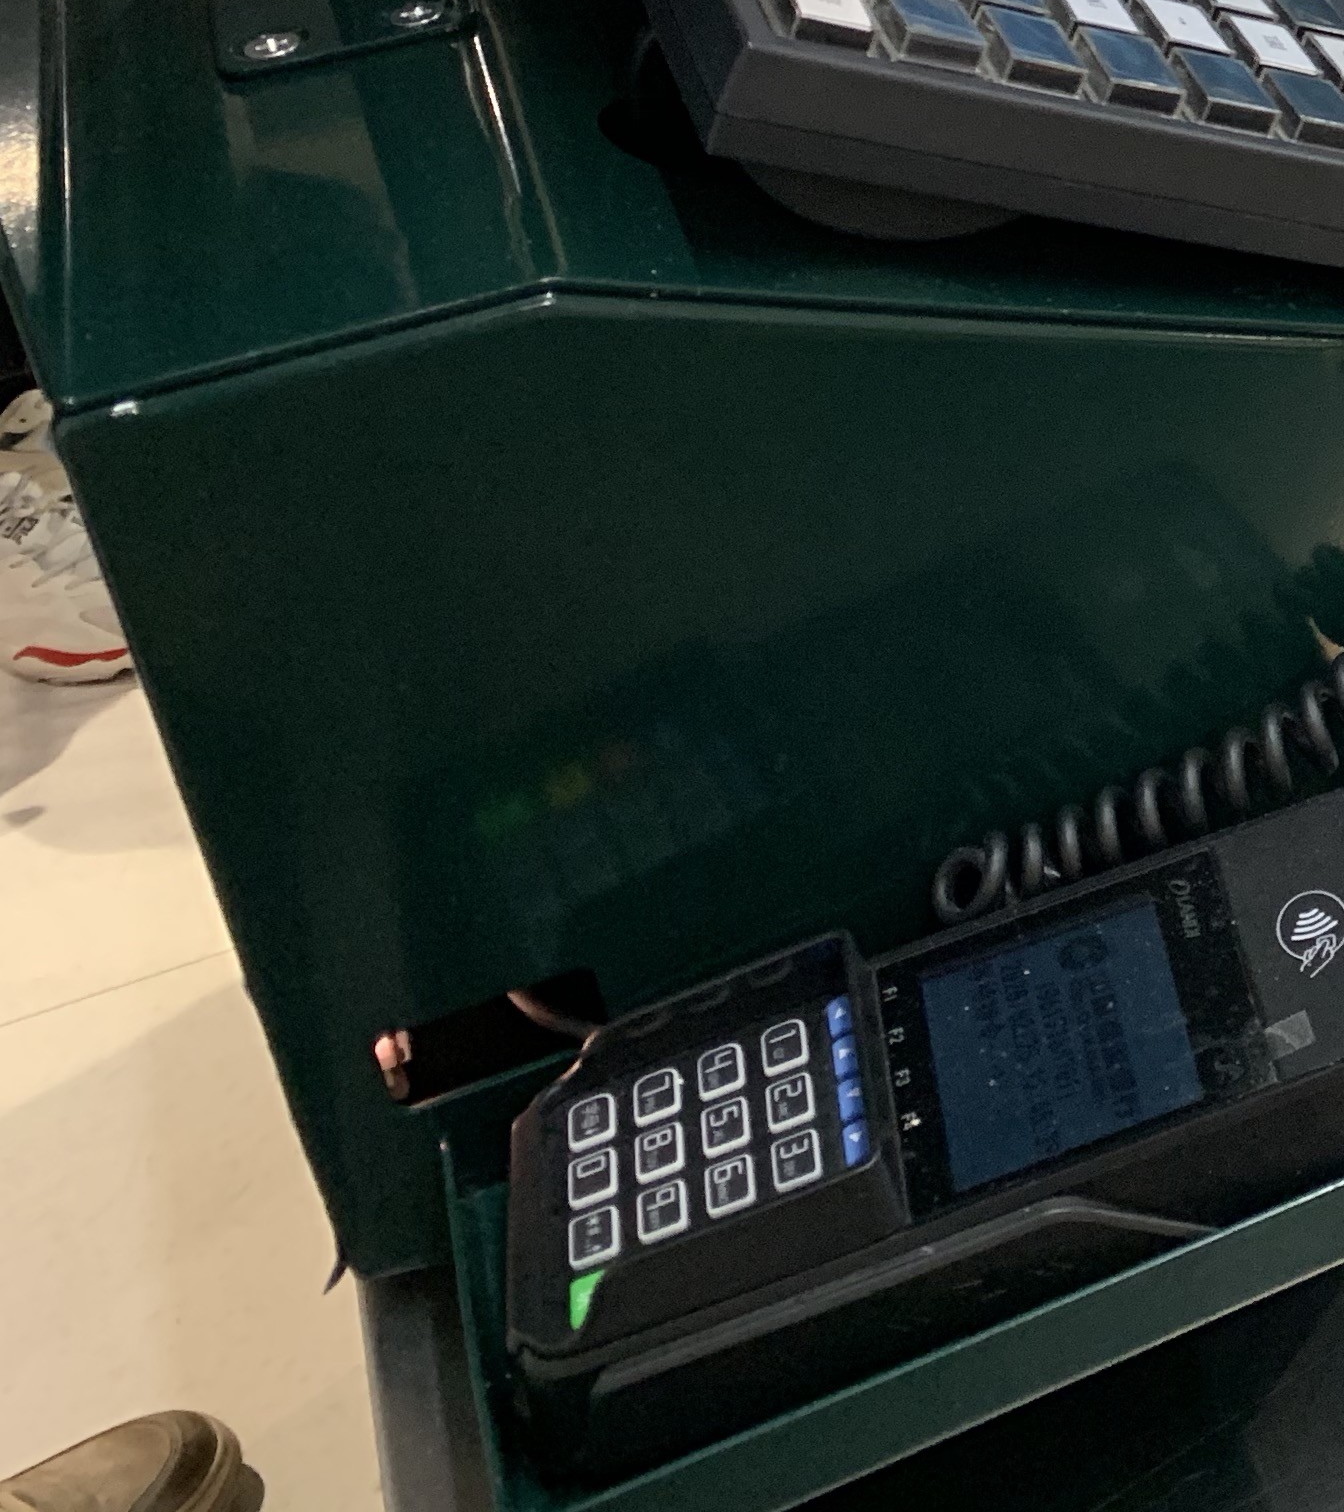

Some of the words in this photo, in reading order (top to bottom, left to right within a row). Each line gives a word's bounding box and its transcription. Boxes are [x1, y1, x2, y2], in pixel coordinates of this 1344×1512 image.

[769, 1028, 796, 1045] 1
[888, 1027, 905, 1045] F2
[703, 1055, 735, 1075] 4
[642, 1076, 672, 1092] 7
[773, 1079, 803, 1103] 2
[708, 1109, 739, 1130] 5
[642, 1127, 673, 1148] 8
[778, 1139, 811, 1158] 3
[575, 1158, 607, 1179] 0
[711, 1164, 744, 1187] 6
[644, 1188, 676, 1210] 9
